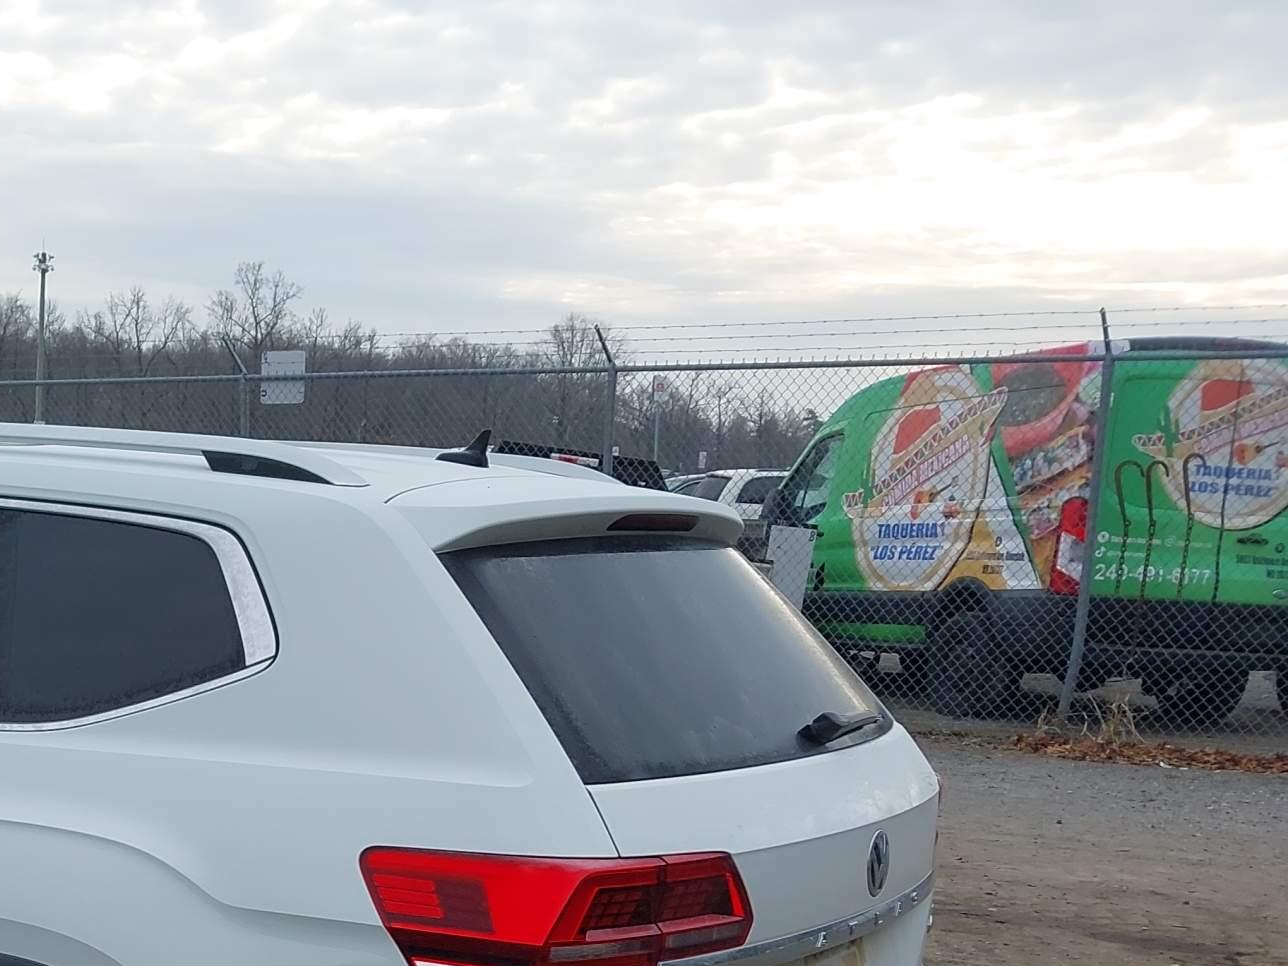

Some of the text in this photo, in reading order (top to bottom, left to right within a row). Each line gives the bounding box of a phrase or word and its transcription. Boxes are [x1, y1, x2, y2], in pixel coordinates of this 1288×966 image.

[1194, 464, 1273, 481] TAQUERIA
[877, 522, 939, 539] TAQUERIA
[871, 541, 944, 561] "LOS PÉREZ"
